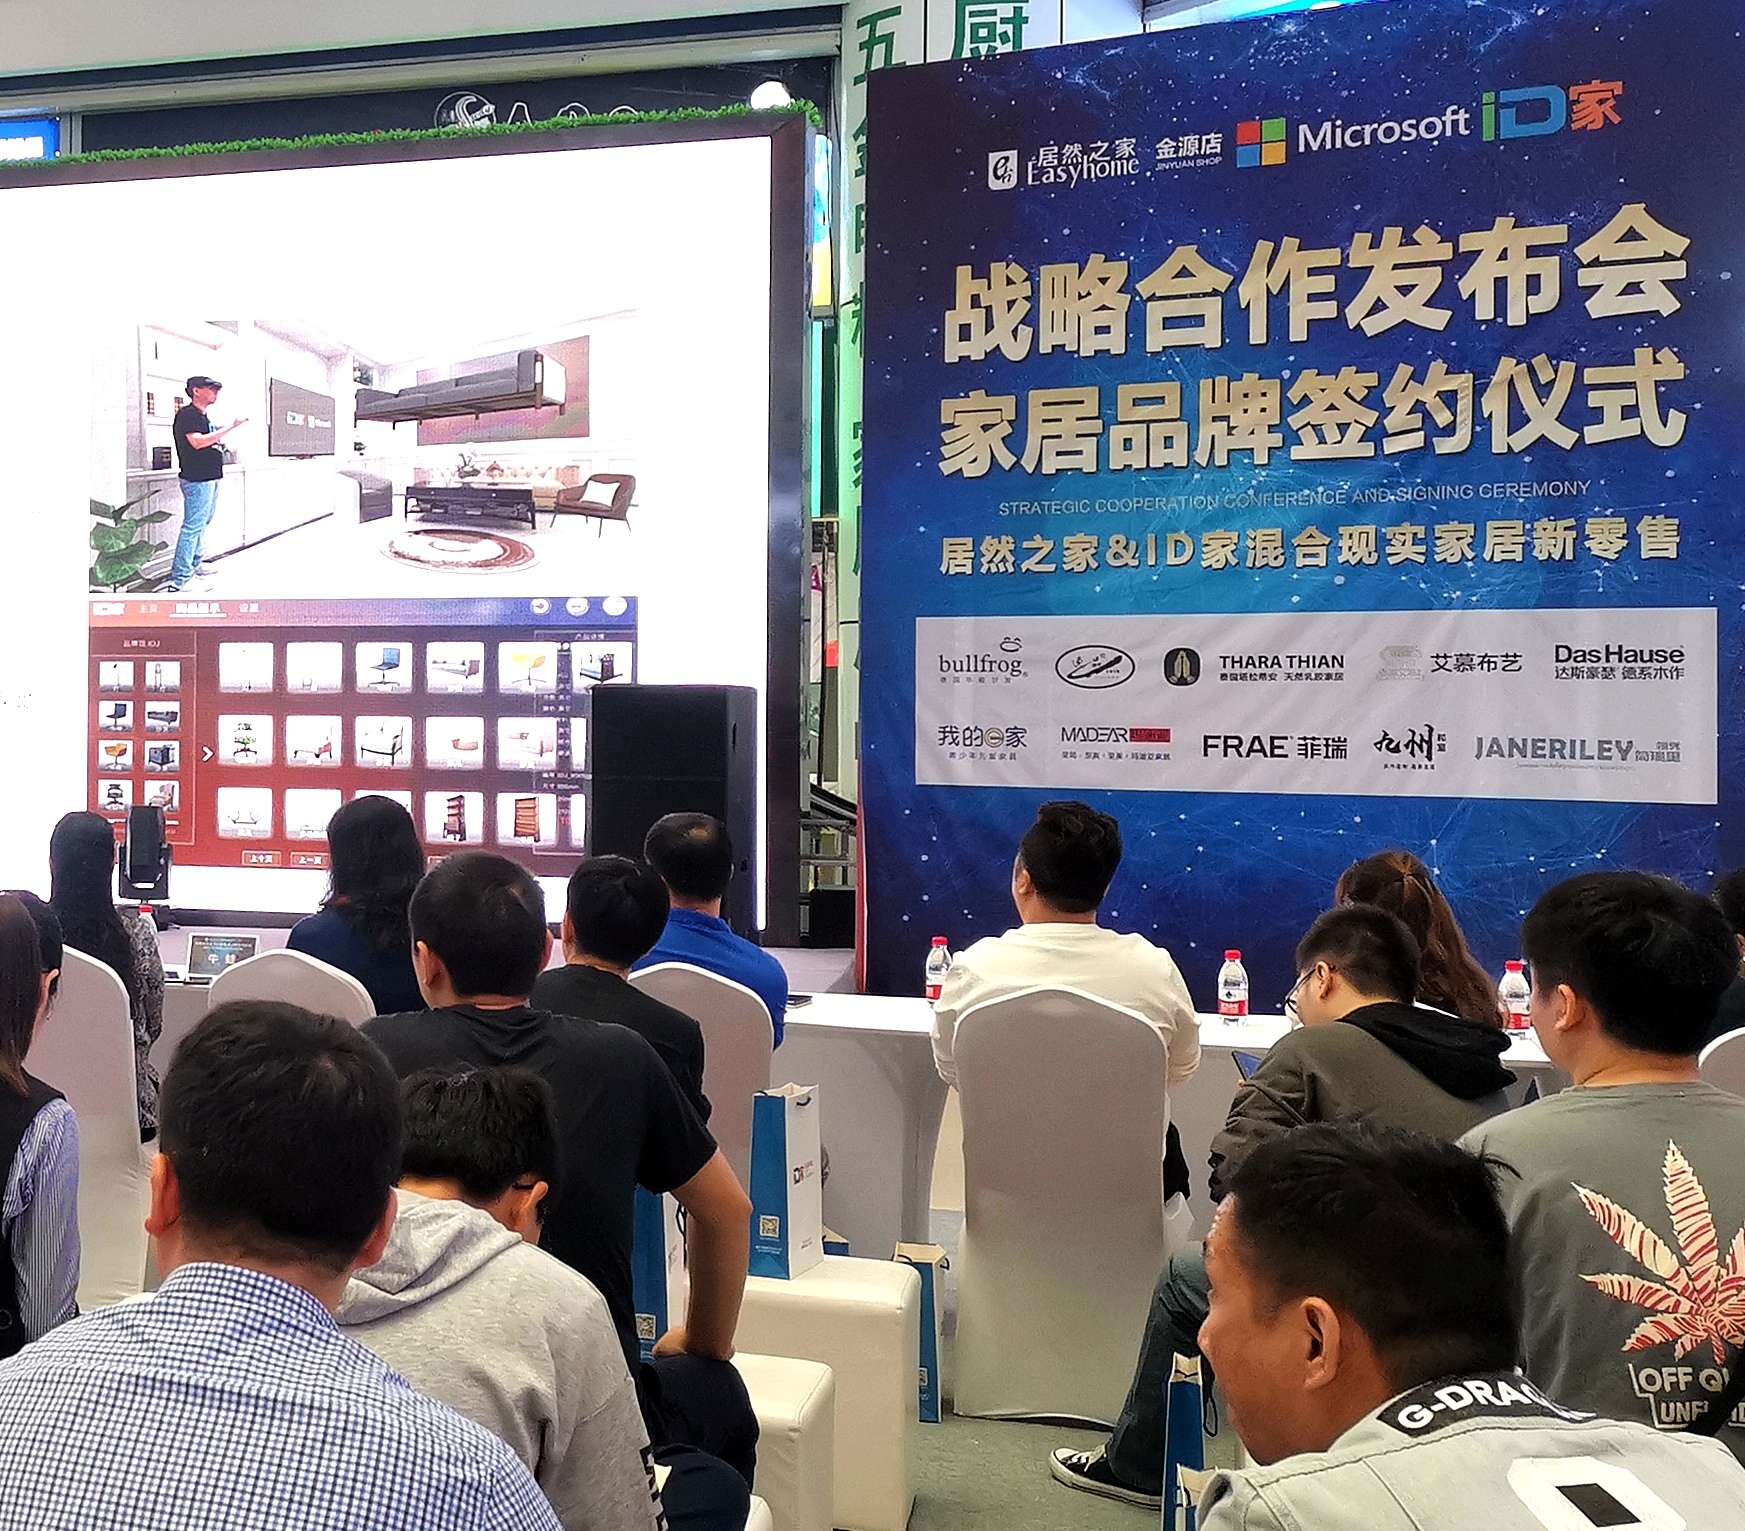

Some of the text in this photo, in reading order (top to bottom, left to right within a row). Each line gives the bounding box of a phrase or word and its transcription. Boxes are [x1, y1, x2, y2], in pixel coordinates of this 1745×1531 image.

[950, 0, 1030, 59] 厨
[1298, 104, 1471, 154] Microsoft
[1038, 138, 1136, 168] 居然之家
[1155, 132, 1223, 159] 金源店
[1027, 150, 1140, 189] Easyhome
[1198, 156, 1223, 167] SHOP
[943, 203, 1690, 364] 战略合作发布会
[939, 347, 1686, 480] 家居品牌签约仪式
[998, 500, 1091, 517] STRATEGIC
[1095, 495, 1219, 514] COOPERATION
[1223, 489, 1346, 509] CONFERENCE
[1352, 485, 1391, 504] AND
[1395, 484, 1474, 502] SIGNING
[939, 514, 1680, 576] 居然之家&ID家混合现实家居新零售
[939, 654, 1023, 677] bullfrog
[1219, 655, 1344, 669] THARA THIAN
[1430, 653, 1523, 673] 艾慕布艺
[1061, 727, 1129, 743] MADEAR
[1203, 734, 1348, 760] FRAE 菲瑞
[1474, 736, 1634, 761] JANERILEY
[1638, 1366, 1693, 1393] OFF
